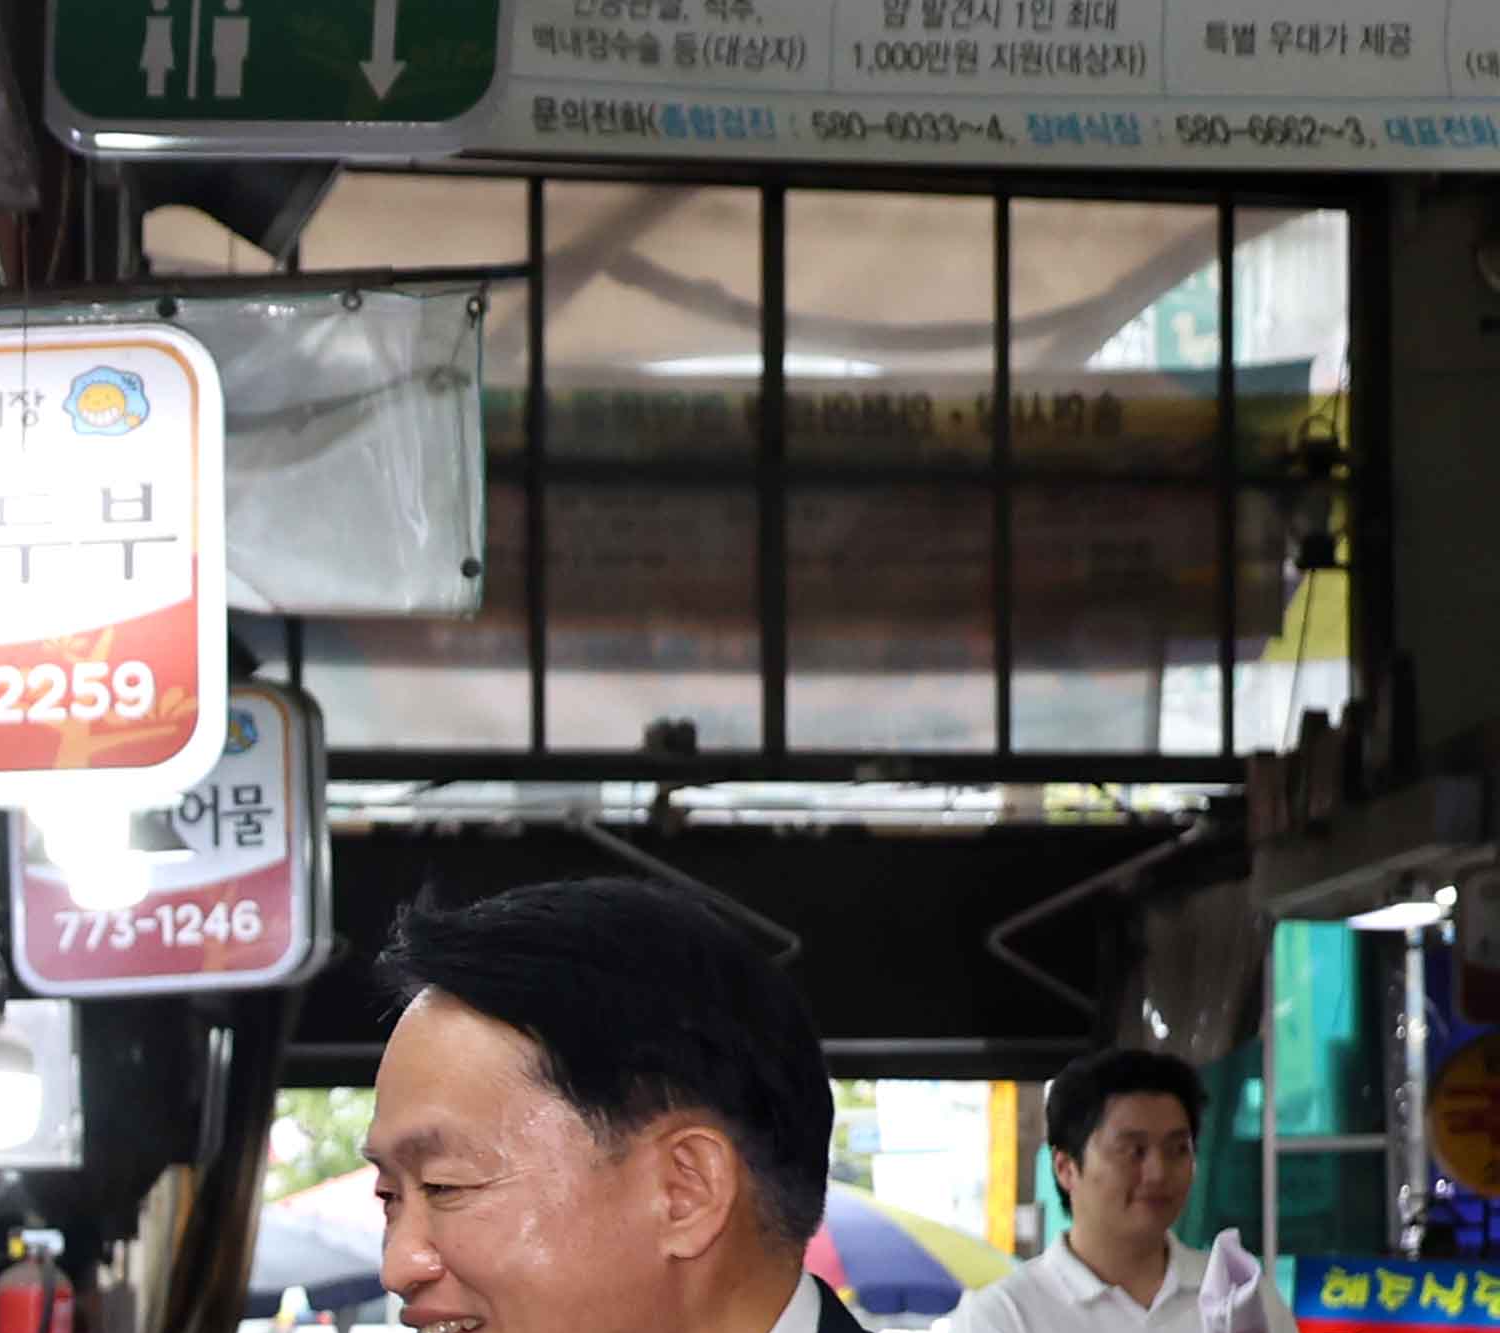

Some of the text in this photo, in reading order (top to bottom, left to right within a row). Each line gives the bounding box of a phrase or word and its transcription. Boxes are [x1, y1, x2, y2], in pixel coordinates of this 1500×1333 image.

[852, 41, 1148, 78] 1,000만원 지원(대상자)
[1204, 20, 1412, 58] 특별 우대가 제공
[160, 783, 274, 850] 어물
[53, 900, 263, 953] 773-1246
